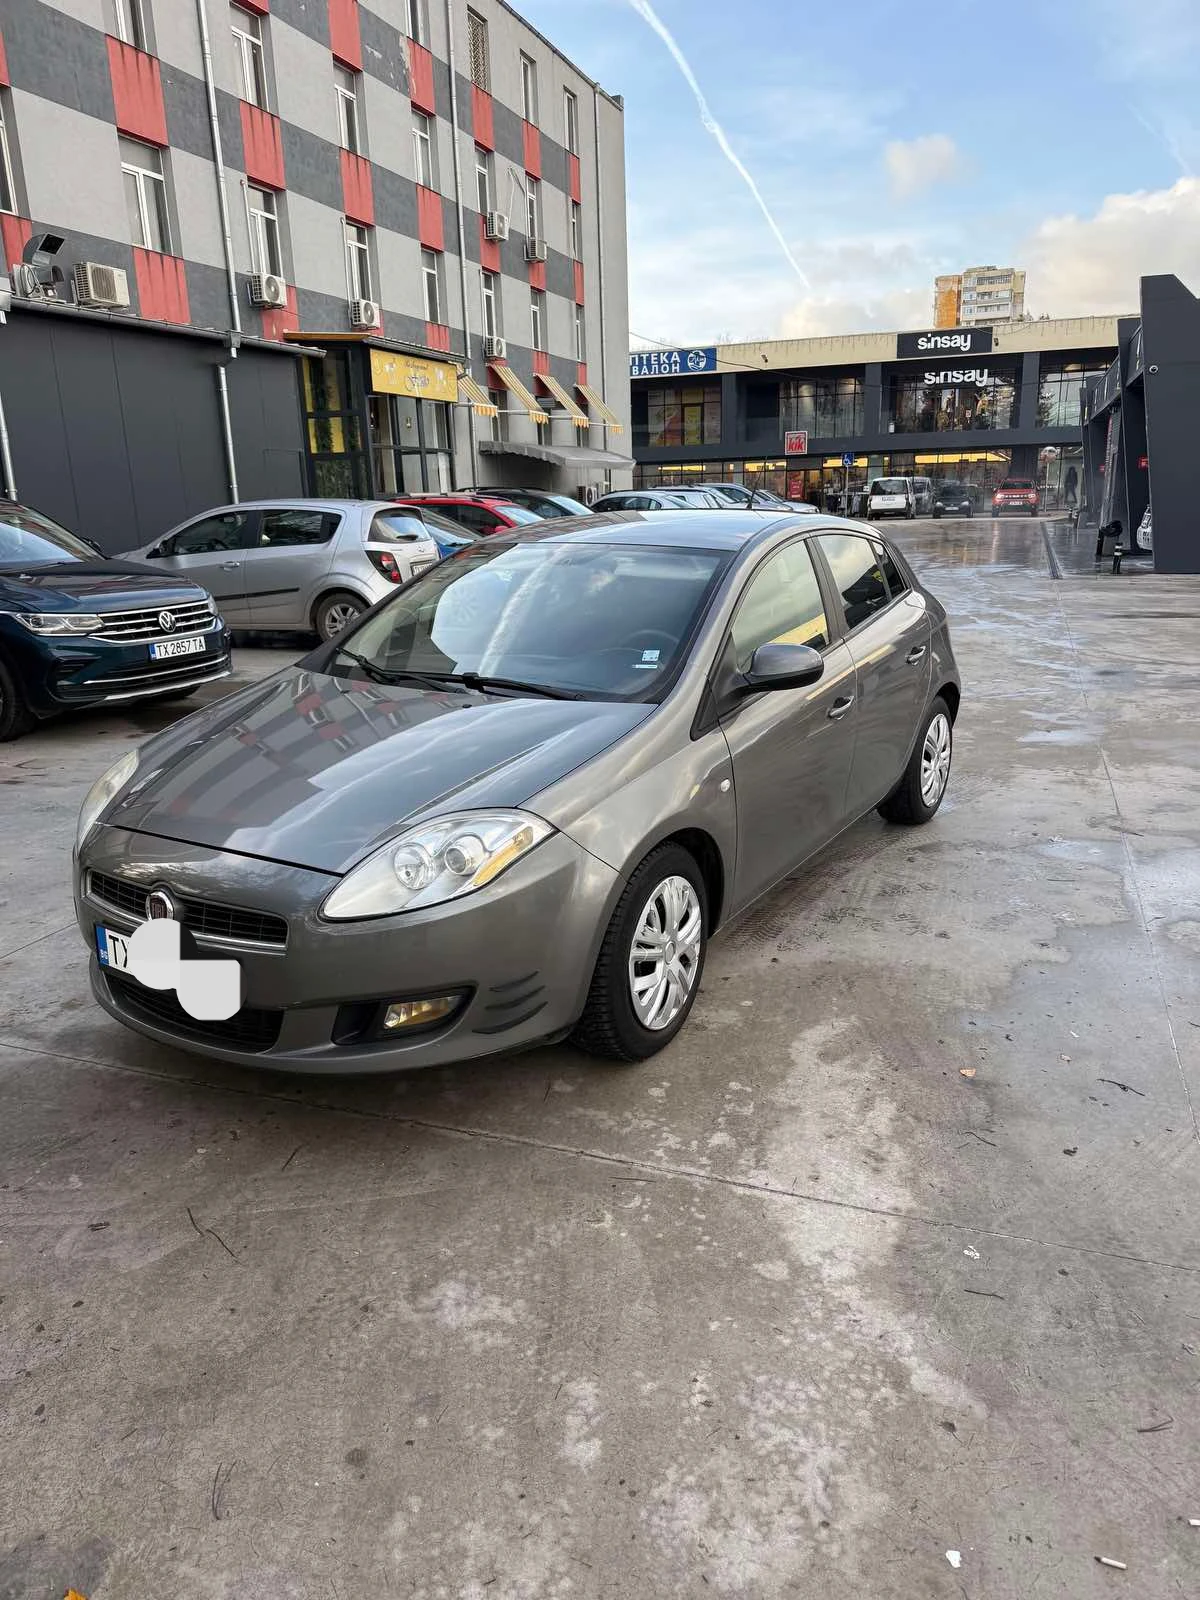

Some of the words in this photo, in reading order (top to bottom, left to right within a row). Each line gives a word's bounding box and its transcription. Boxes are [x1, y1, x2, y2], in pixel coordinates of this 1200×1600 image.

[917, 333, 972, 352] sinsay
[923, 368, 989, 387] sinsay
[170, 640, 191, 655] 2857
